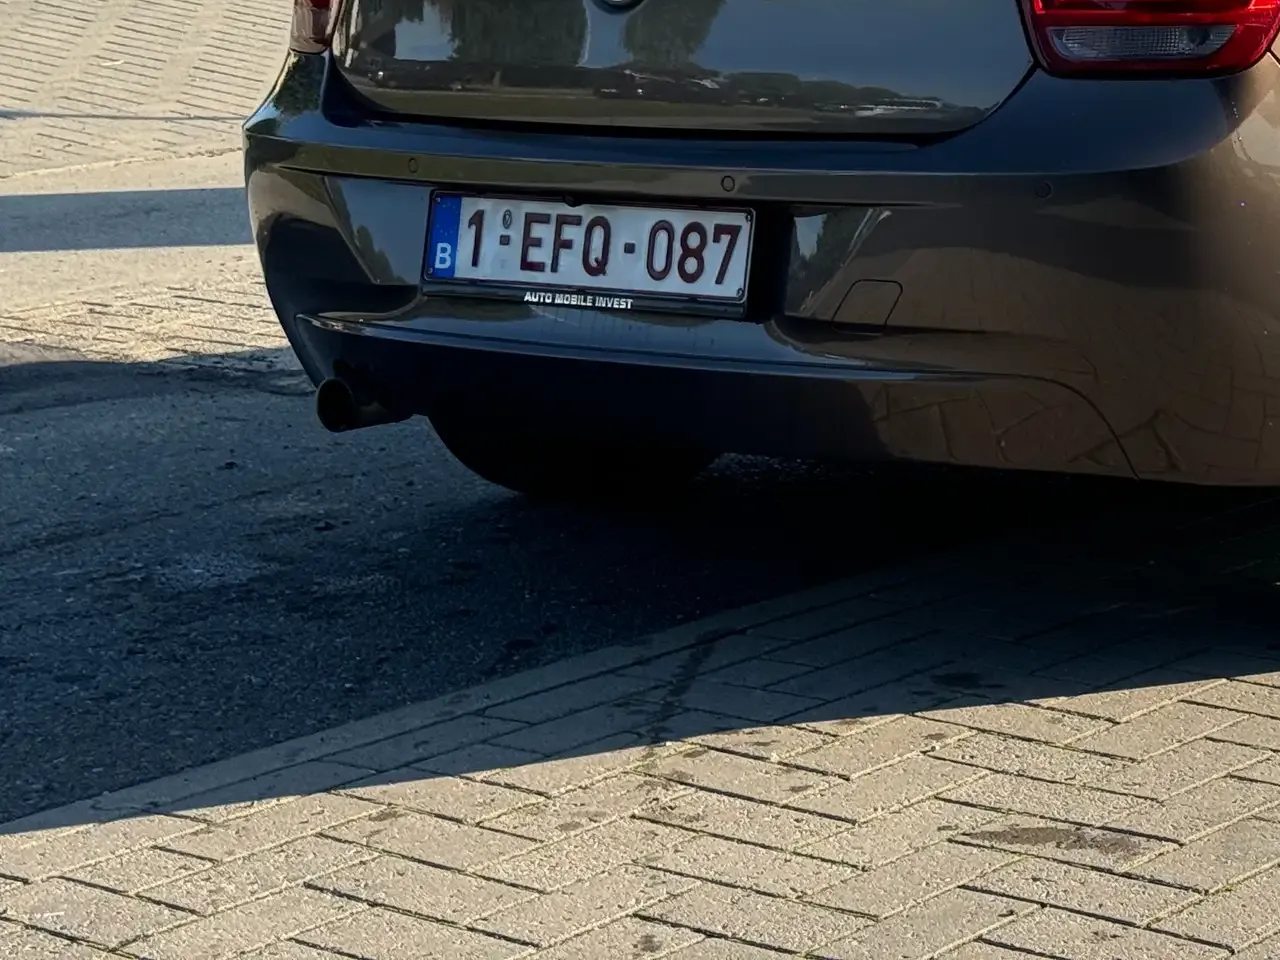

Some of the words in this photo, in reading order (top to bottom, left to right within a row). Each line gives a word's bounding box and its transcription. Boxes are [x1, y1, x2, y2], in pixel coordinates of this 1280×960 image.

[434, 243, 452, 269] B
[467, 209, 743, 285] 1-EFQ-087
[524, 291, 552, 303] AUTO
[554, 293, 593, 306] MOBILE
[595, 296, 633, 309] INVEST
